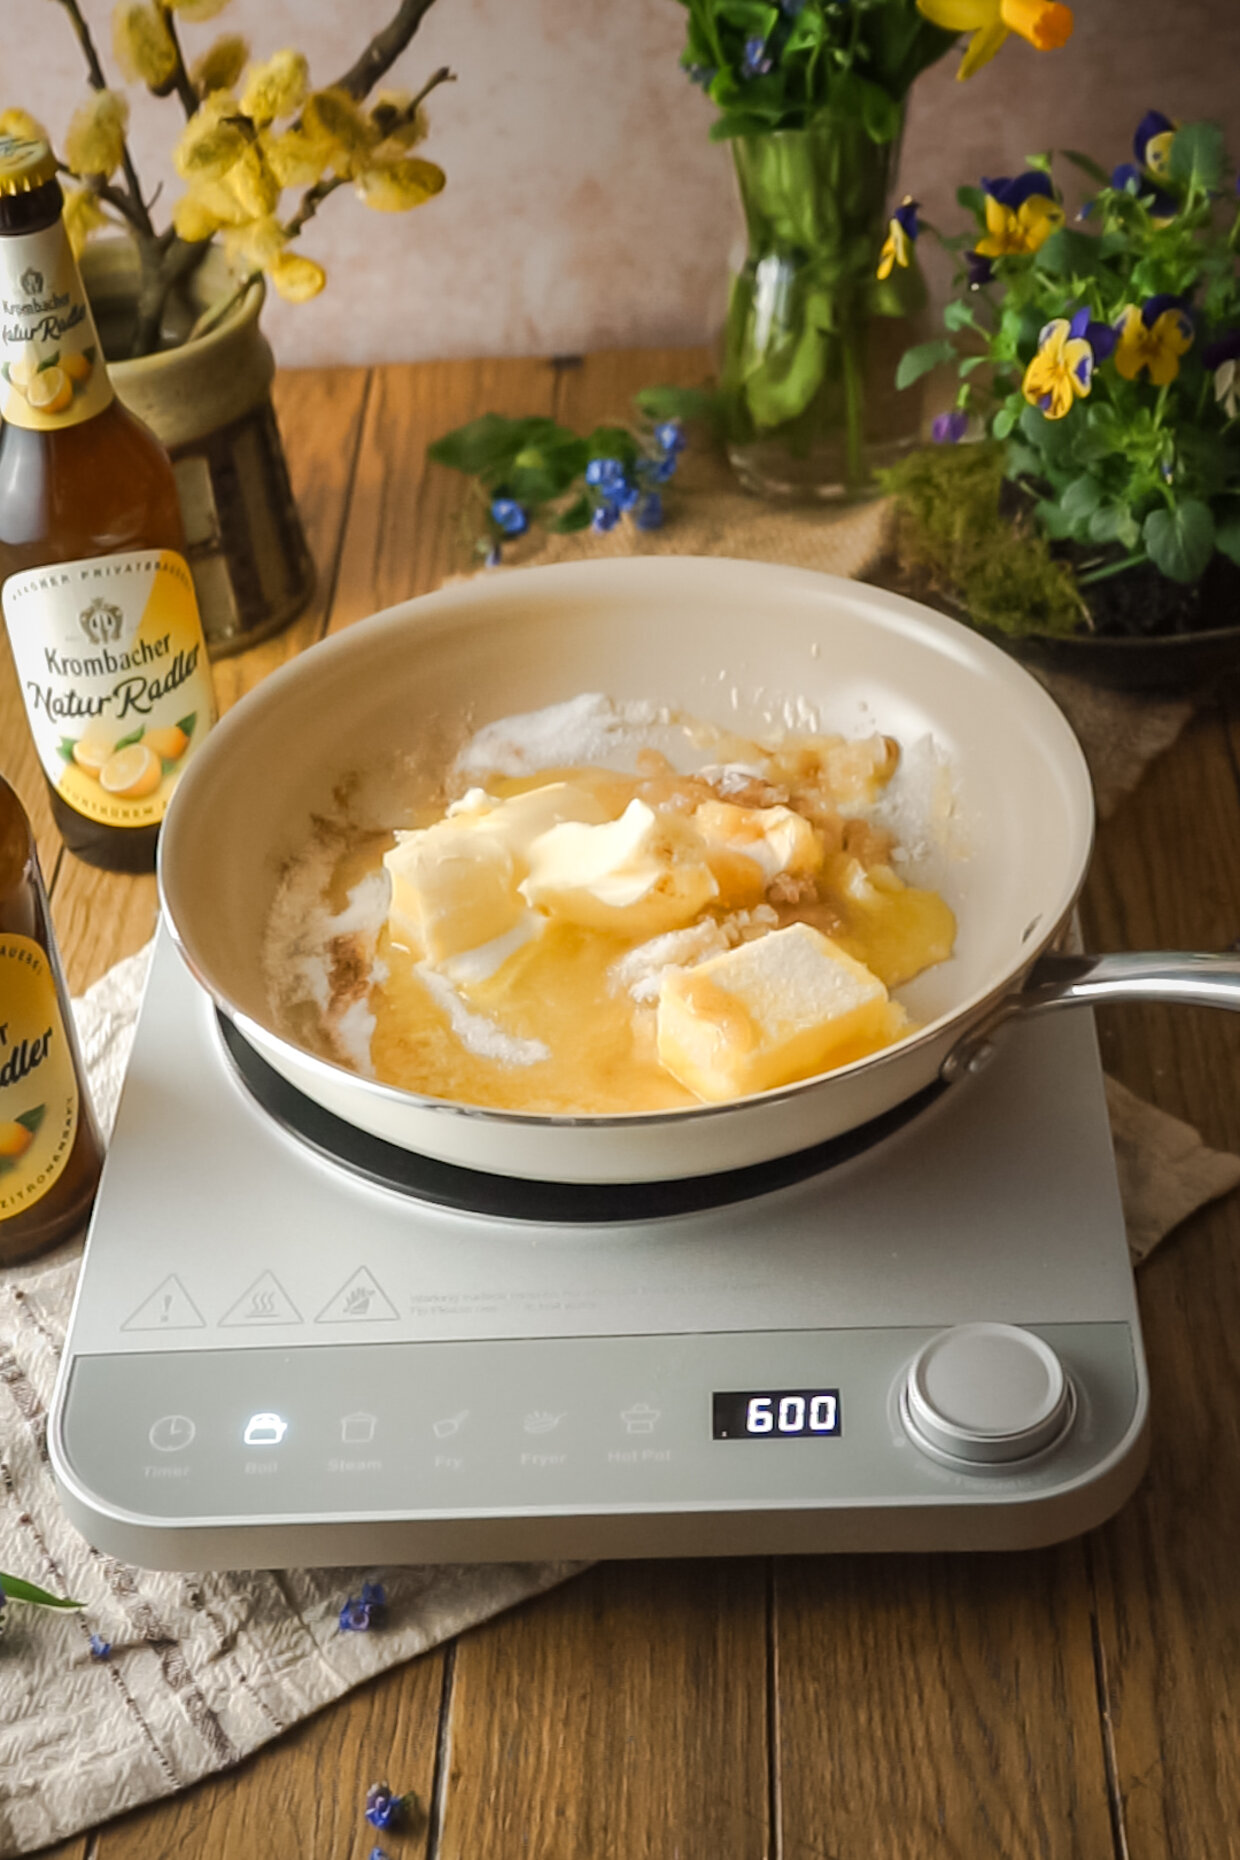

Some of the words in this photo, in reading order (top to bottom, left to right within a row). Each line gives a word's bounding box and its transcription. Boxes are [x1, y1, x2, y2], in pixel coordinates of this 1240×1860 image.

[43, 633, 172, 677] Krombacher
[746, 1394, 836, 1433] 600
[244, 1461, 278, 1475] Boil
[326, 1458, 382, 1473] Steam
[434, 1454, 463, 1471] Fry
[142, 1465, 191, 1479] Timer
